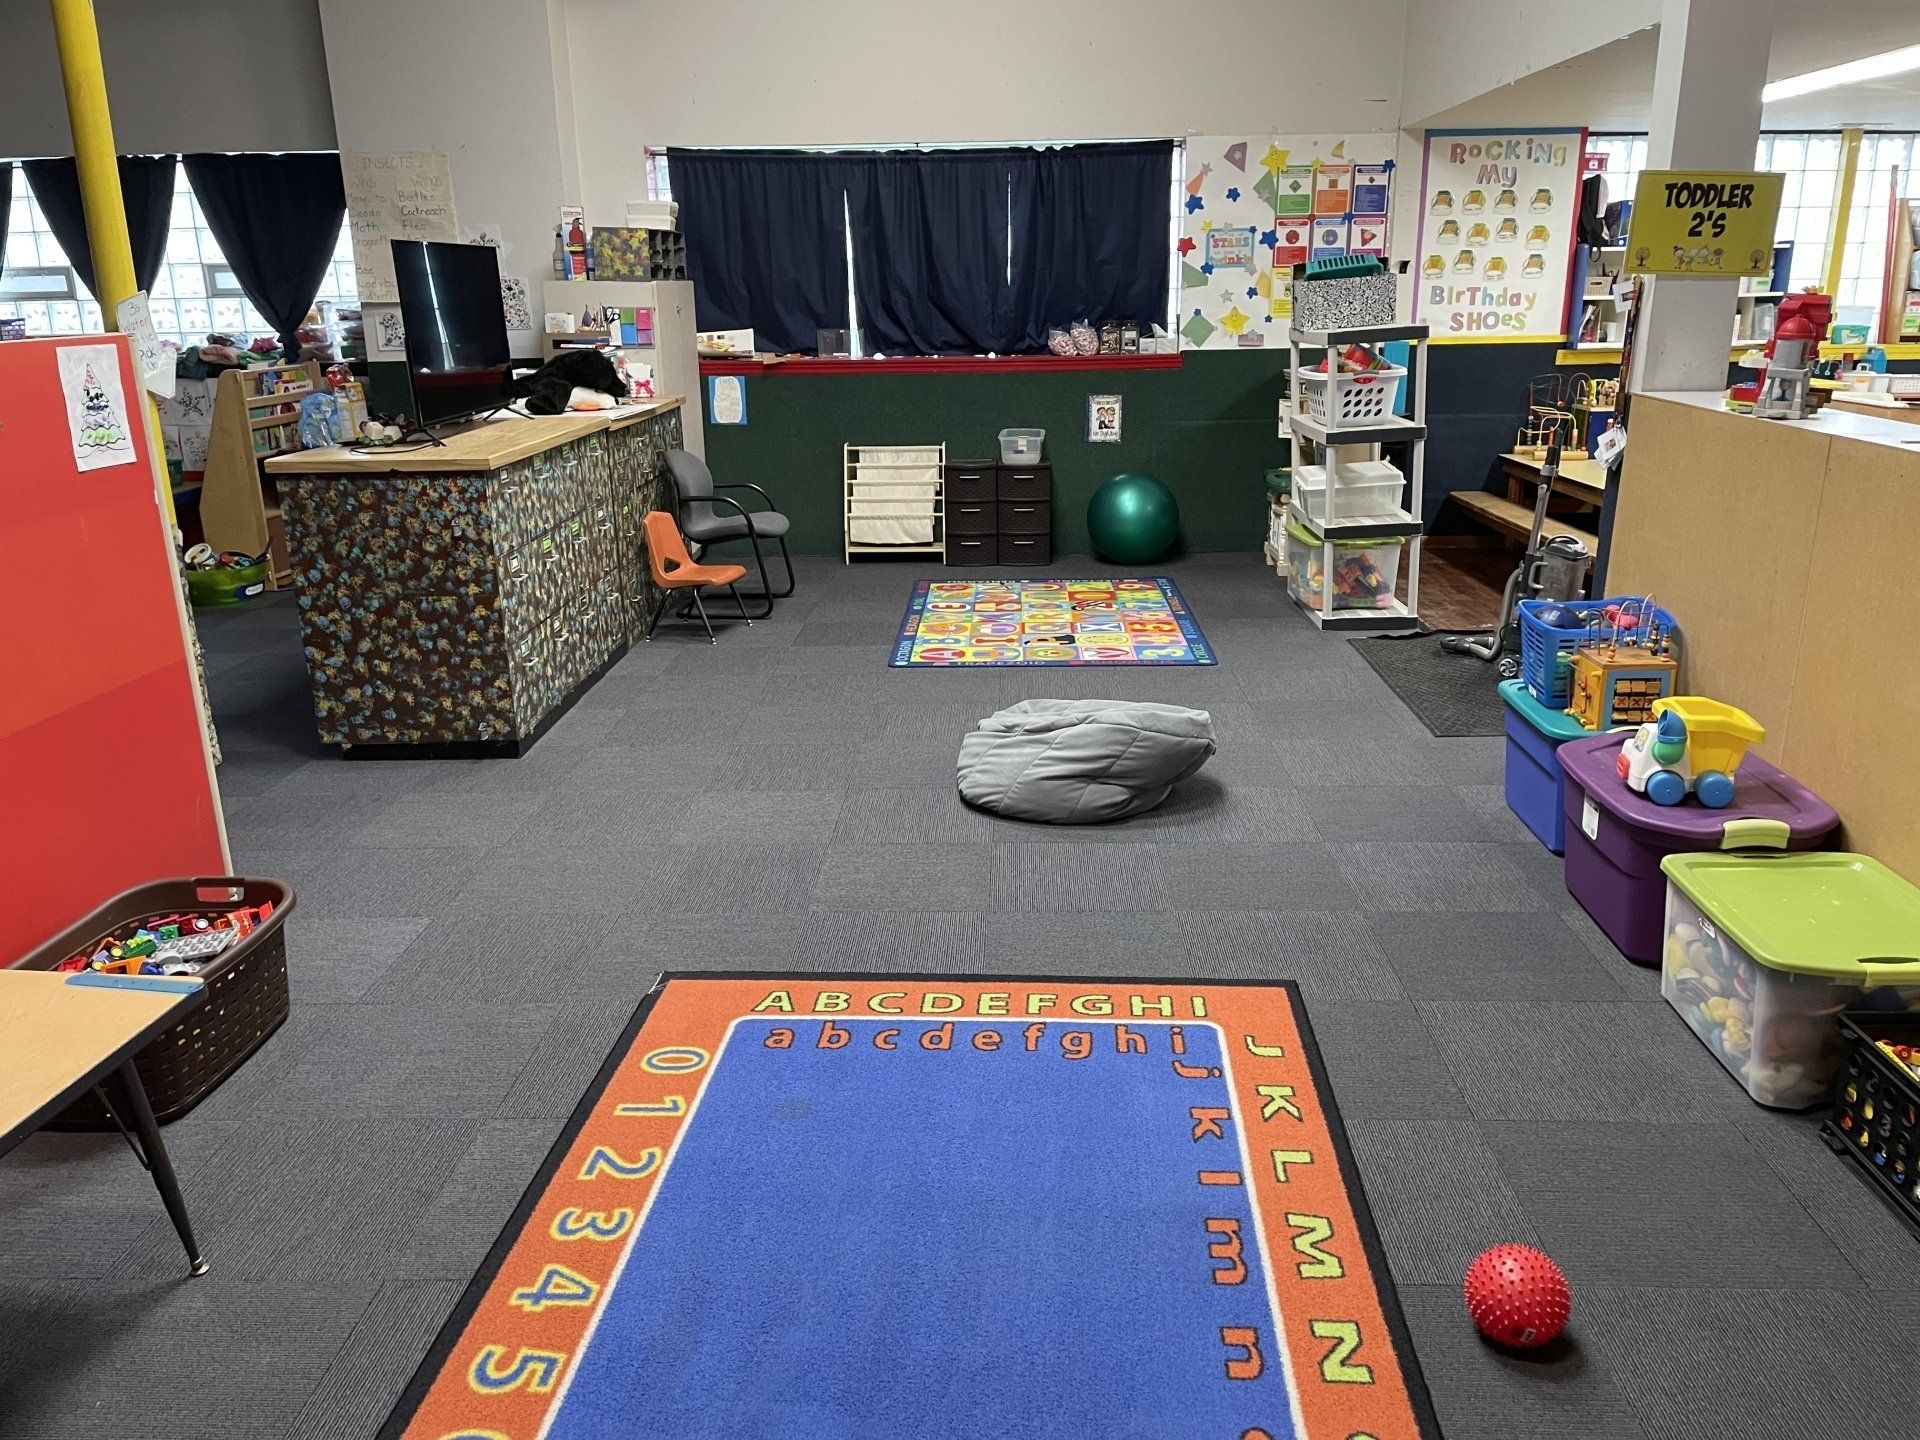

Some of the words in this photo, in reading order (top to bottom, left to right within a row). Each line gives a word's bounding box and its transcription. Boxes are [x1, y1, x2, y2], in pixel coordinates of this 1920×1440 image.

[1475, 163, 1518, 188] My
[1664, 182, 1754, 209] TODDLER
[1256, 1084, 1303, 1123] K
[577, 1145, 664, 1181] 2
[1271, 1148, 1314, 1184] L
[550, 1206, 635, 1242] 3
[1285, 1212, 1346, 1280] M
[510, 1262, 601, 1313] 4
[467, 1343, 568, 1395] 5
[1309, 1319, 1376, 1385] N
